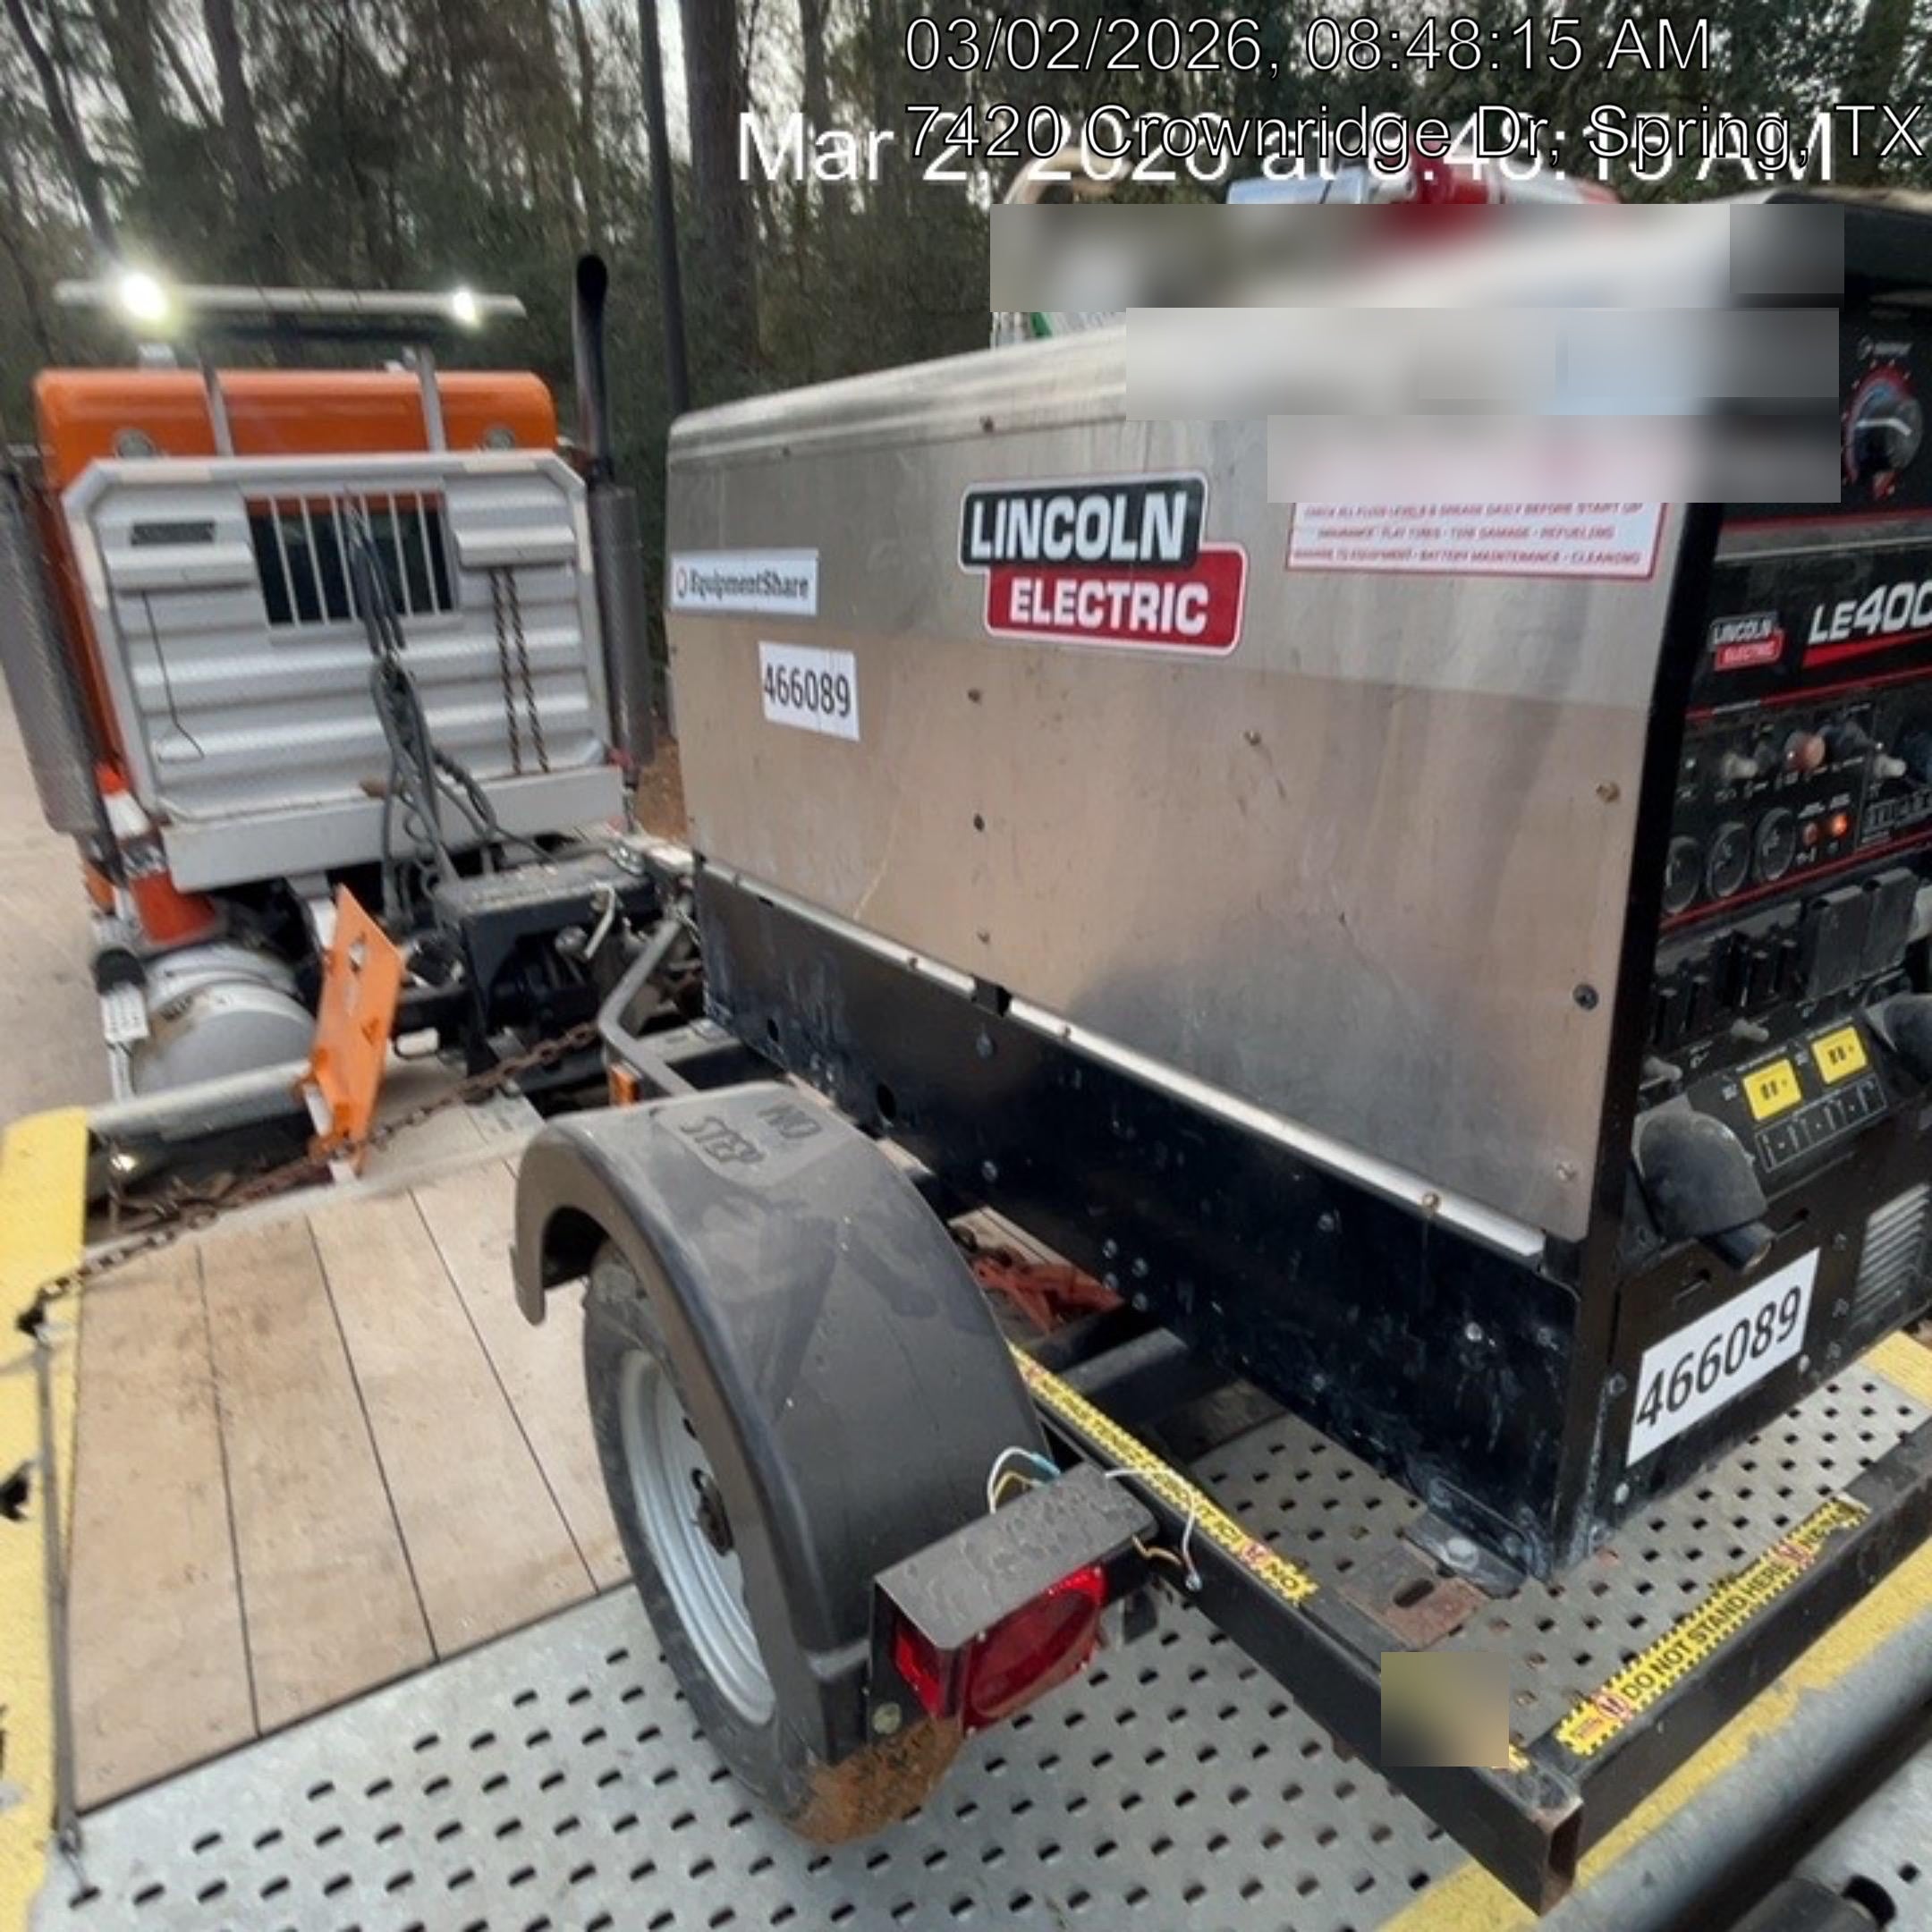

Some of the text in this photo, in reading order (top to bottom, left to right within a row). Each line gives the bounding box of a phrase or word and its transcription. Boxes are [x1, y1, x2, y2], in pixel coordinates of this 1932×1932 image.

[969, 491, 1187, 562] LINCOLN
[690, 567, 809, 600] EquipmentShare
[1008, 577, 1210, 635] ELECTRIC
[1714, 618, 1773, 645] LINCOLN
[764, 662, 851, 717] 466089
[1635, 1284, 1802, 1428] 466089
[1620, 1671, 1656, 1700] DO
[1648, 1640, 1691, 1675] NOT
[1686, 1594, 1749, 1643] STAND
[1744, 1558, 1788, 1597] HERE
